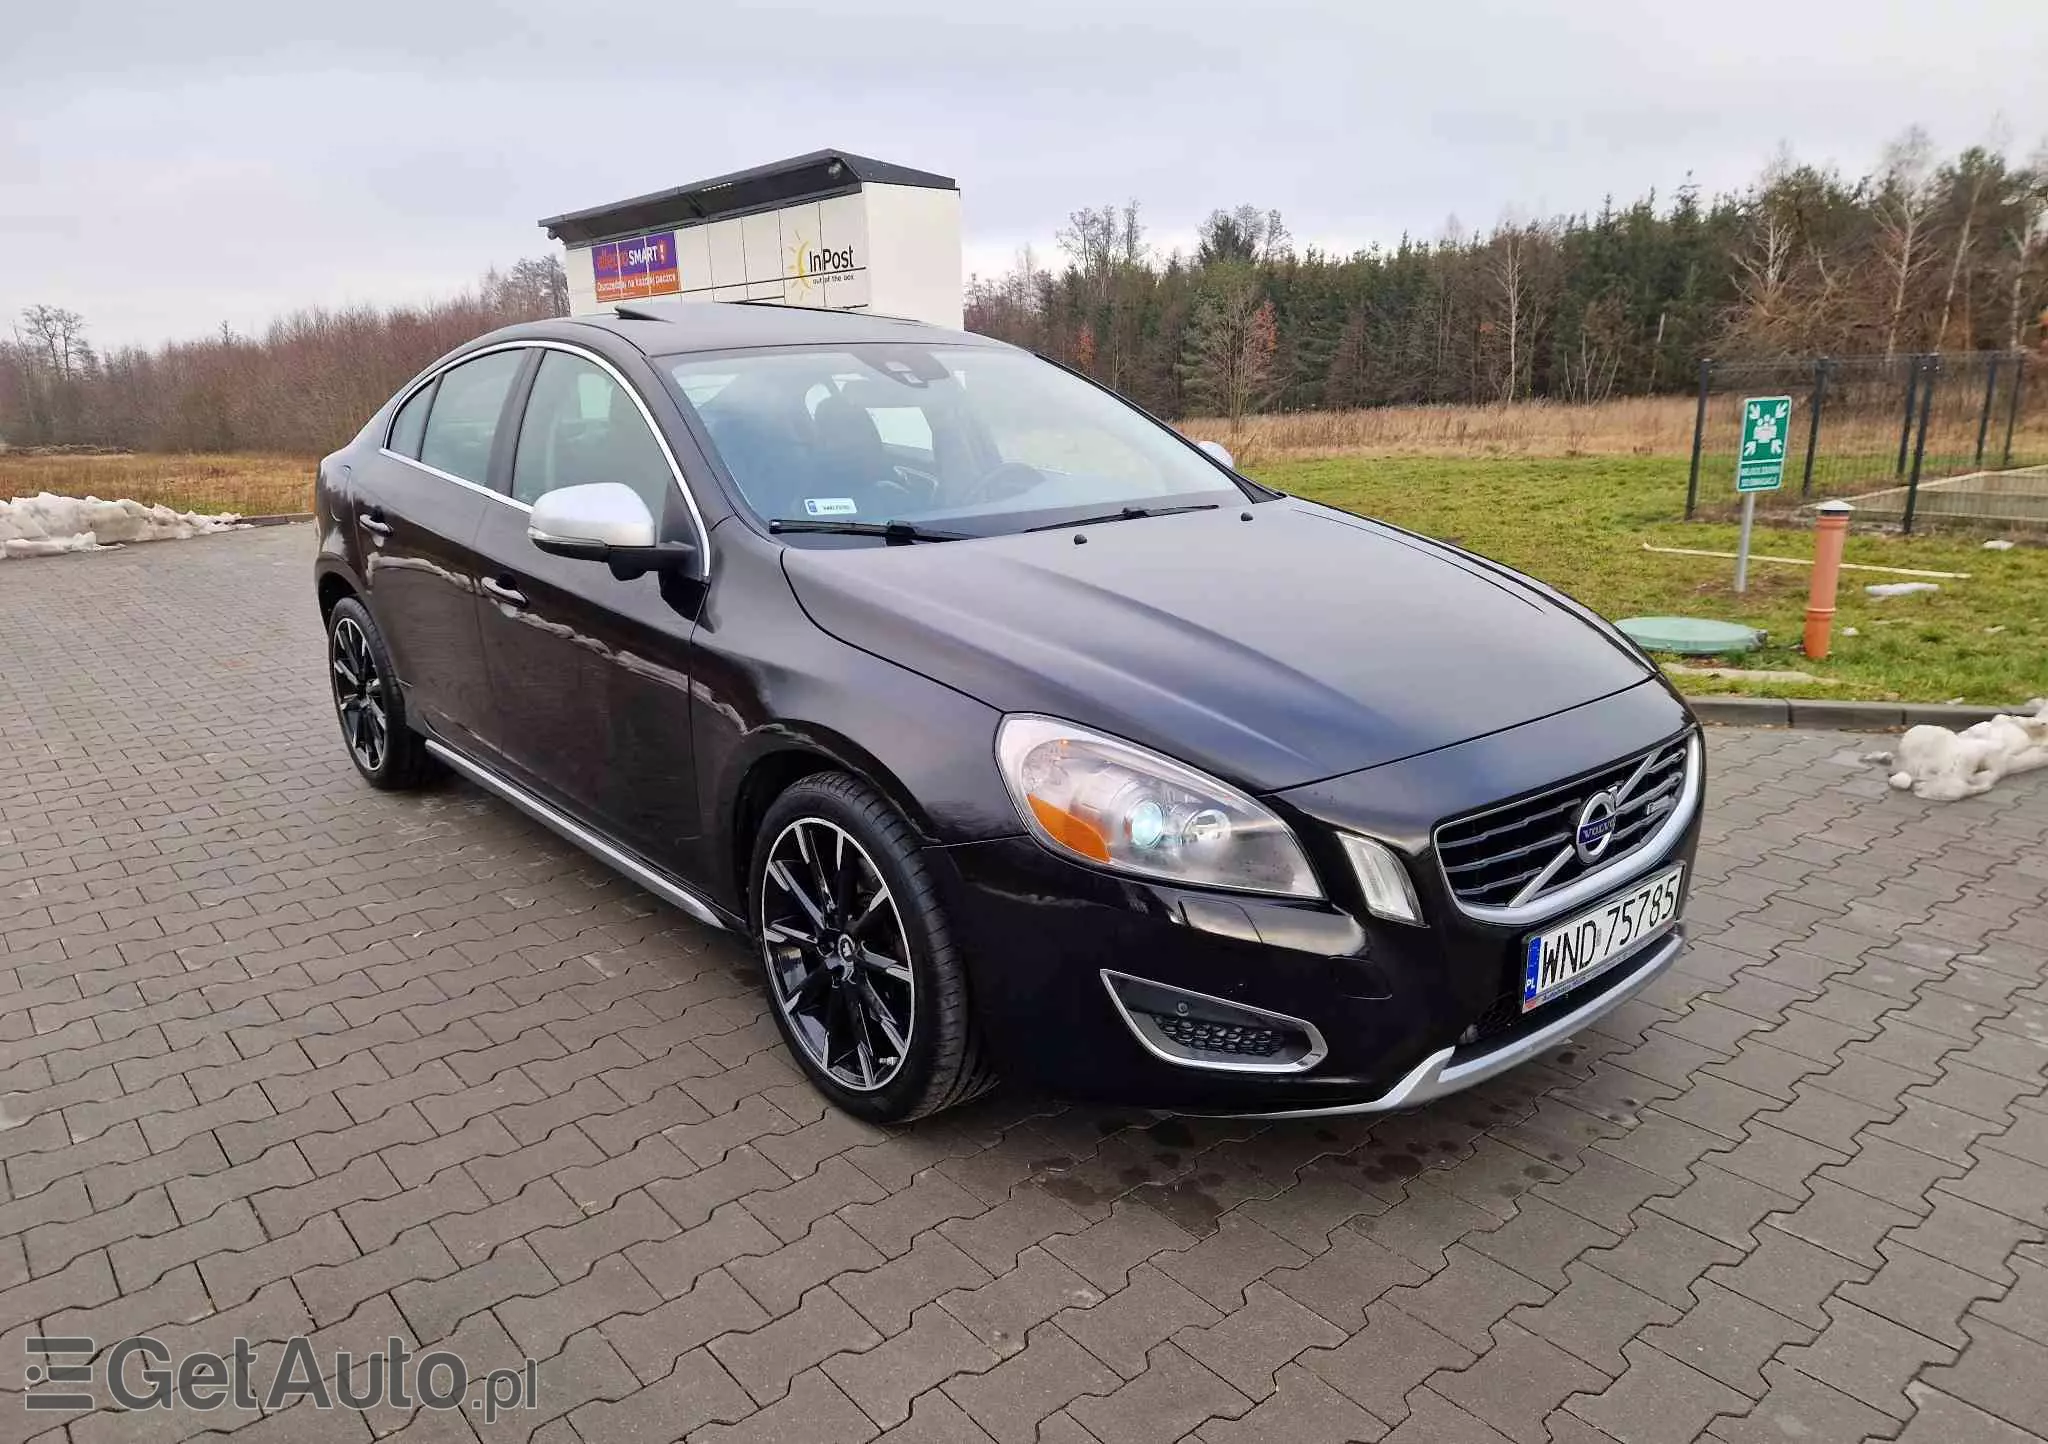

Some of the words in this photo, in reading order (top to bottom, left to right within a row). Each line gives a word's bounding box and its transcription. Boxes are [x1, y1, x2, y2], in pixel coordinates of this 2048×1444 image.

[809, 244, 854, 272] InPost
[813, 277, 822, 285] out
[832, 274, 842, 282] the
[1541, 920, 1597, 988] WND
[1604, 874, 1678, 956] 75785
[1525, 978, 1535, 989] PL
